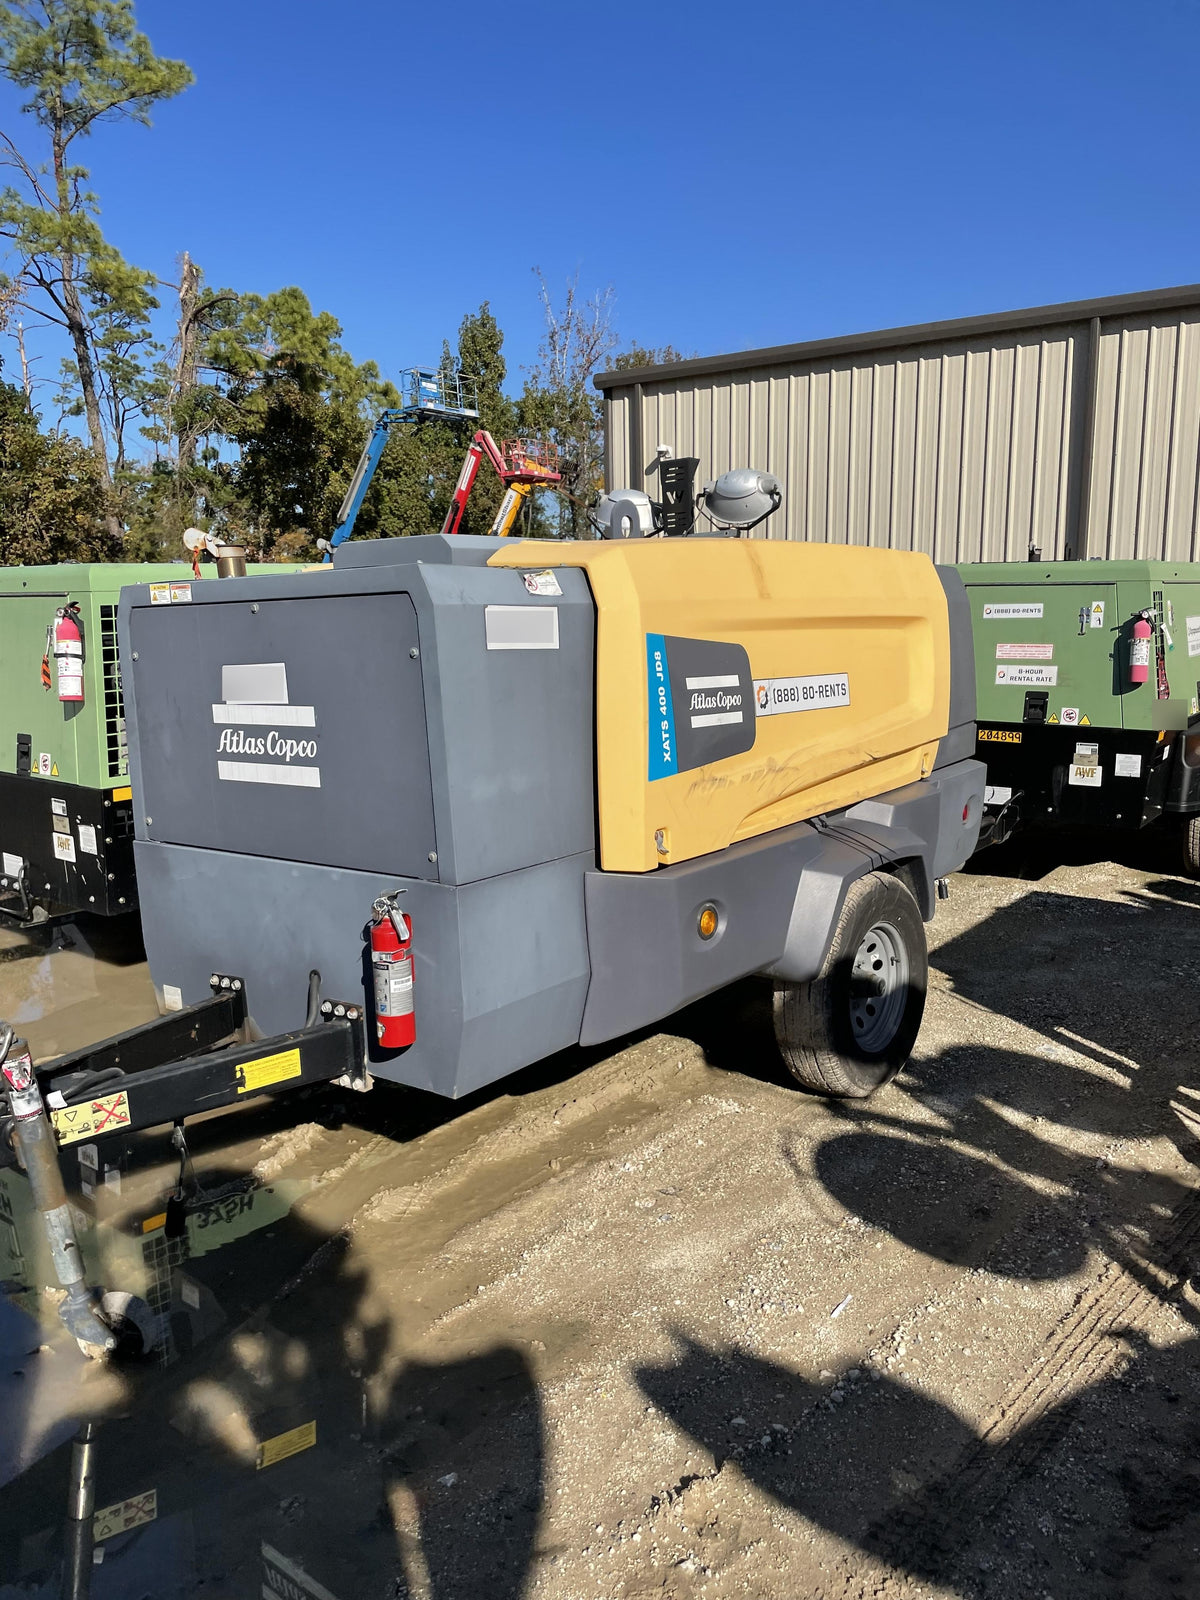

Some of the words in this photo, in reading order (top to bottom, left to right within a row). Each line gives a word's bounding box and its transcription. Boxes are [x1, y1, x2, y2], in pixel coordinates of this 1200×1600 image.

[654, 651, 664, 682] JD8
[658, 686, 667, 716] 400
[689, 692, 716, 710] Atlas
[717, 691, 742, 710] Copco
[773, 686, 799, 704] (888)
[802, 683, 847, 700] 80-RENTS
[216, 729, 265, 755] Atlas
[266, 731, 317, 762] Copco
[661, 720, 671, 762] XATS
[979, 730, 1021, 742] 204899
